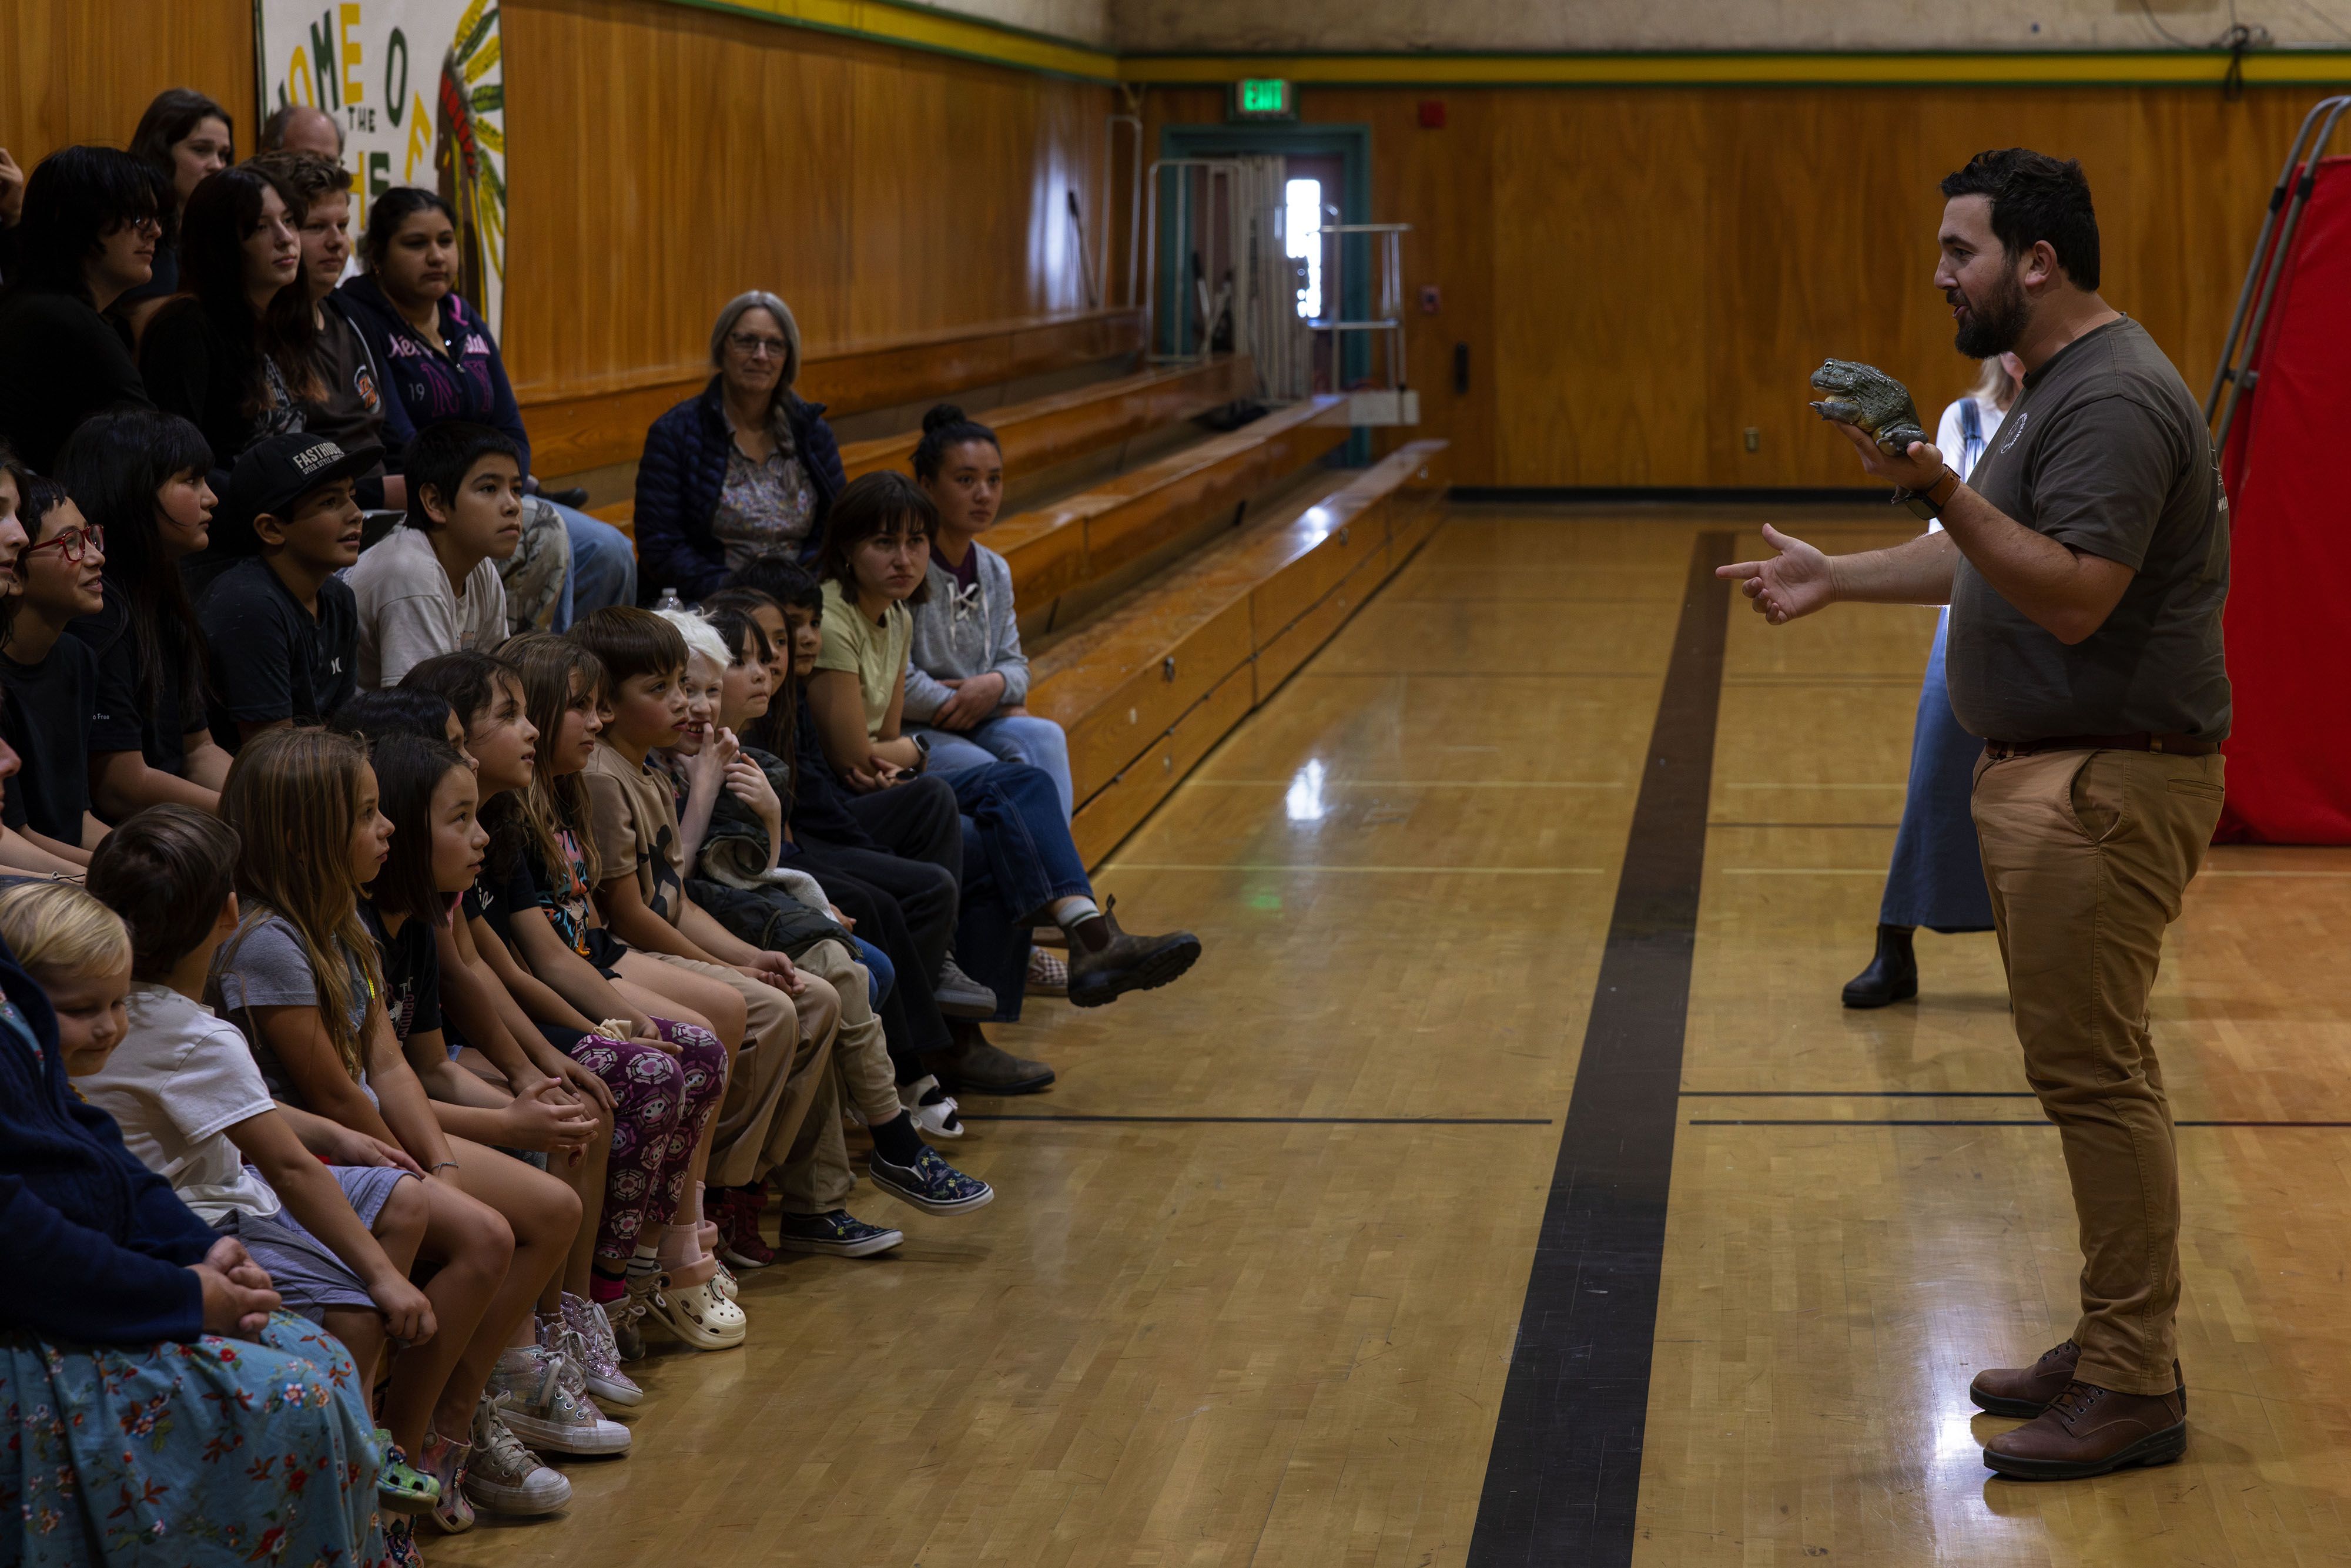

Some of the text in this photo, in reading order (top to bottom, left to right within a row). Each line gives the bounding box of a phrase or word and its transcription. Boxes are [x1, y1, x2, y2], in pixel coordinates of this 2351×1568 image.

[269, 4, 432, 183] OME OF
[348, 106, 376, 133] THE
[408, 383, 425, 401] 19
